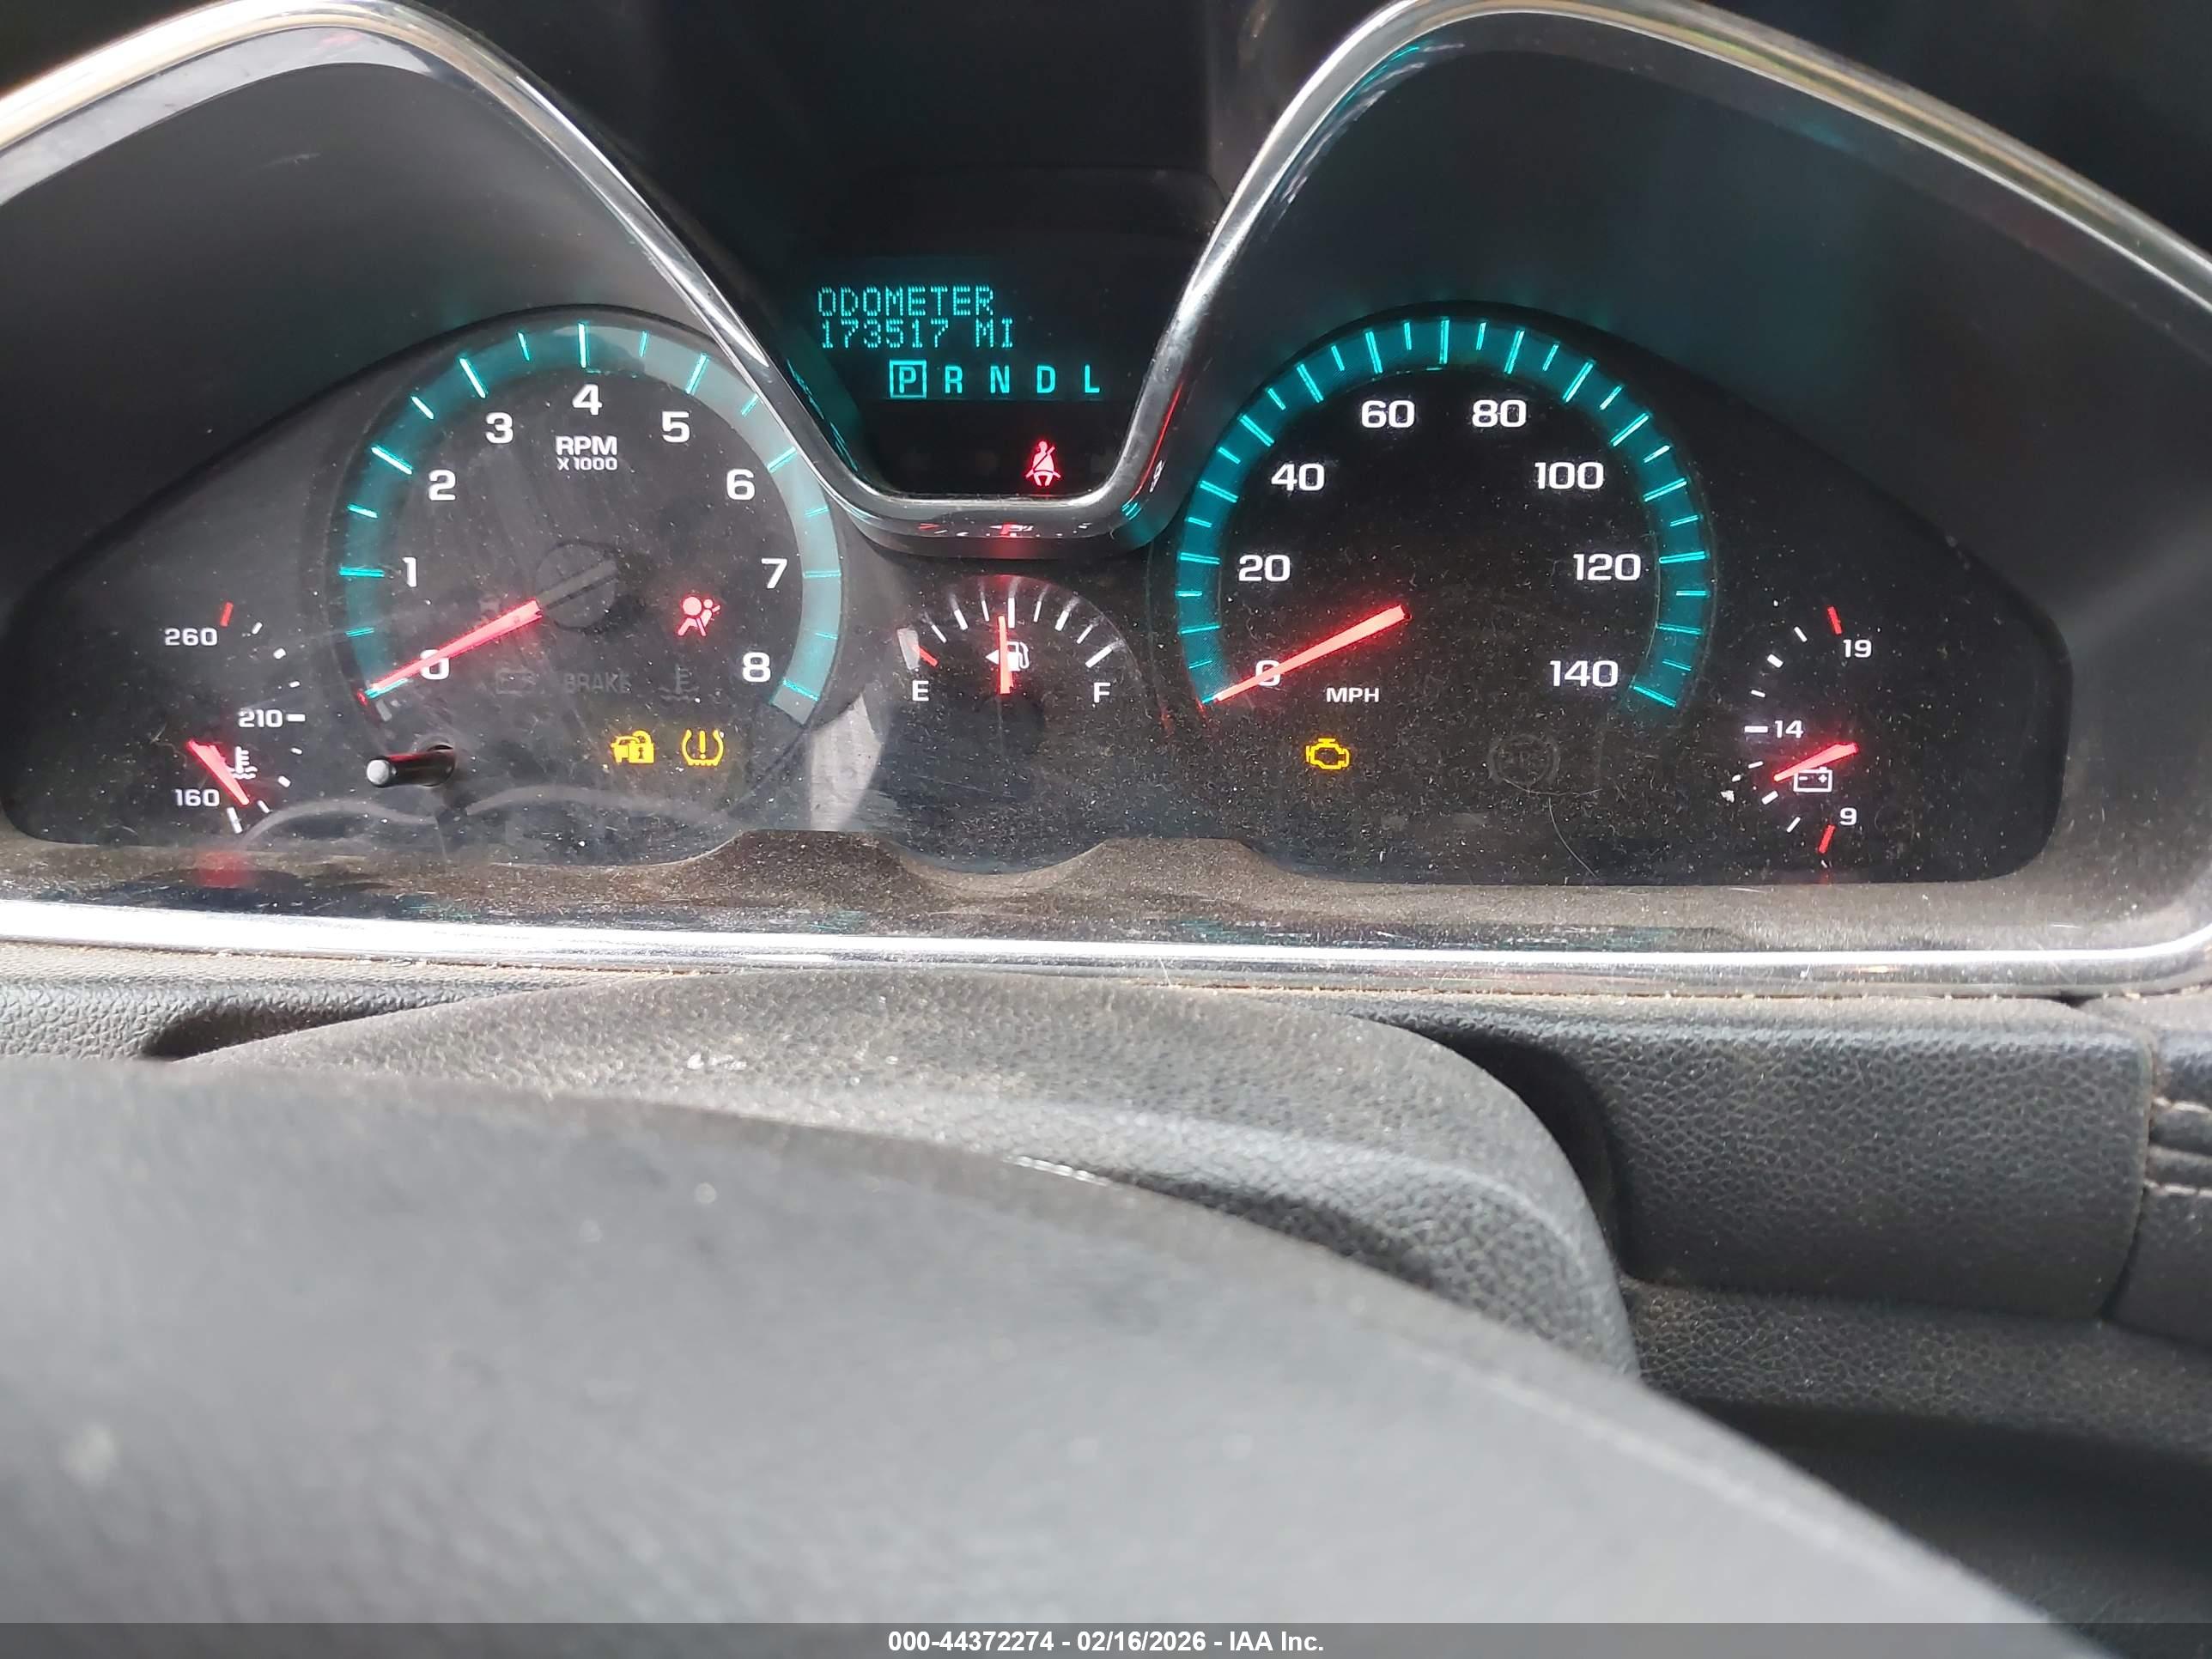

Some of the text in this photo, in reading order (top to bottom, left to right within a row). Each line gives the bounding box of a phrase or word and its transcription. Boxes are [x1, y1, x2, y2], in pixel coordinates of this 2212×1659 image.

[818, 286, 994, 317] ODOMETER
[822, 318, 1013, 349] 173517 MI
[898, 364, 1100, 394] P R N D L
[572, 384, 603, 416] 4
[1361, 399, 1415, 428] 60
[1472, 399, 1527, 428] 80
[485, 412, 514, 444] 3
[662, 410, 690, 443] 5
[556, 435, 617, 456] RPM
[428, 469, 456, 501] 2
[726, 468, 756, 501] 6
[1271, 463, 1325, 491] 40
[1534, 461, 1605, 489] 100
[402, 556, 417, 587] 1
[761, 557, 788, 589] 7
[1238, 554, 1291, 582] 20
[1573, 553, 1642, 581] 120
[165, 627, 218, 647] 260
[1843, 639, 1872, 658] 19
[420, 649, 449, 680] 0
[742, 652, 771, 683] 8
[1255, 660, 1280, 687] 0
[1549, 659, 1619, 689] 140
[562, 672, 632, 694] BRAKE
[912, 679, 929, 702] E
[1093, 682, 1111, 703] F
[1326, 687, 1380, 703] MPH
[238, 708, 283, 728] 210
[1774, 720, 1804, 739] 14
[174, 788, 220, 807] 160
[1839, 807, 1857, 826] 9
